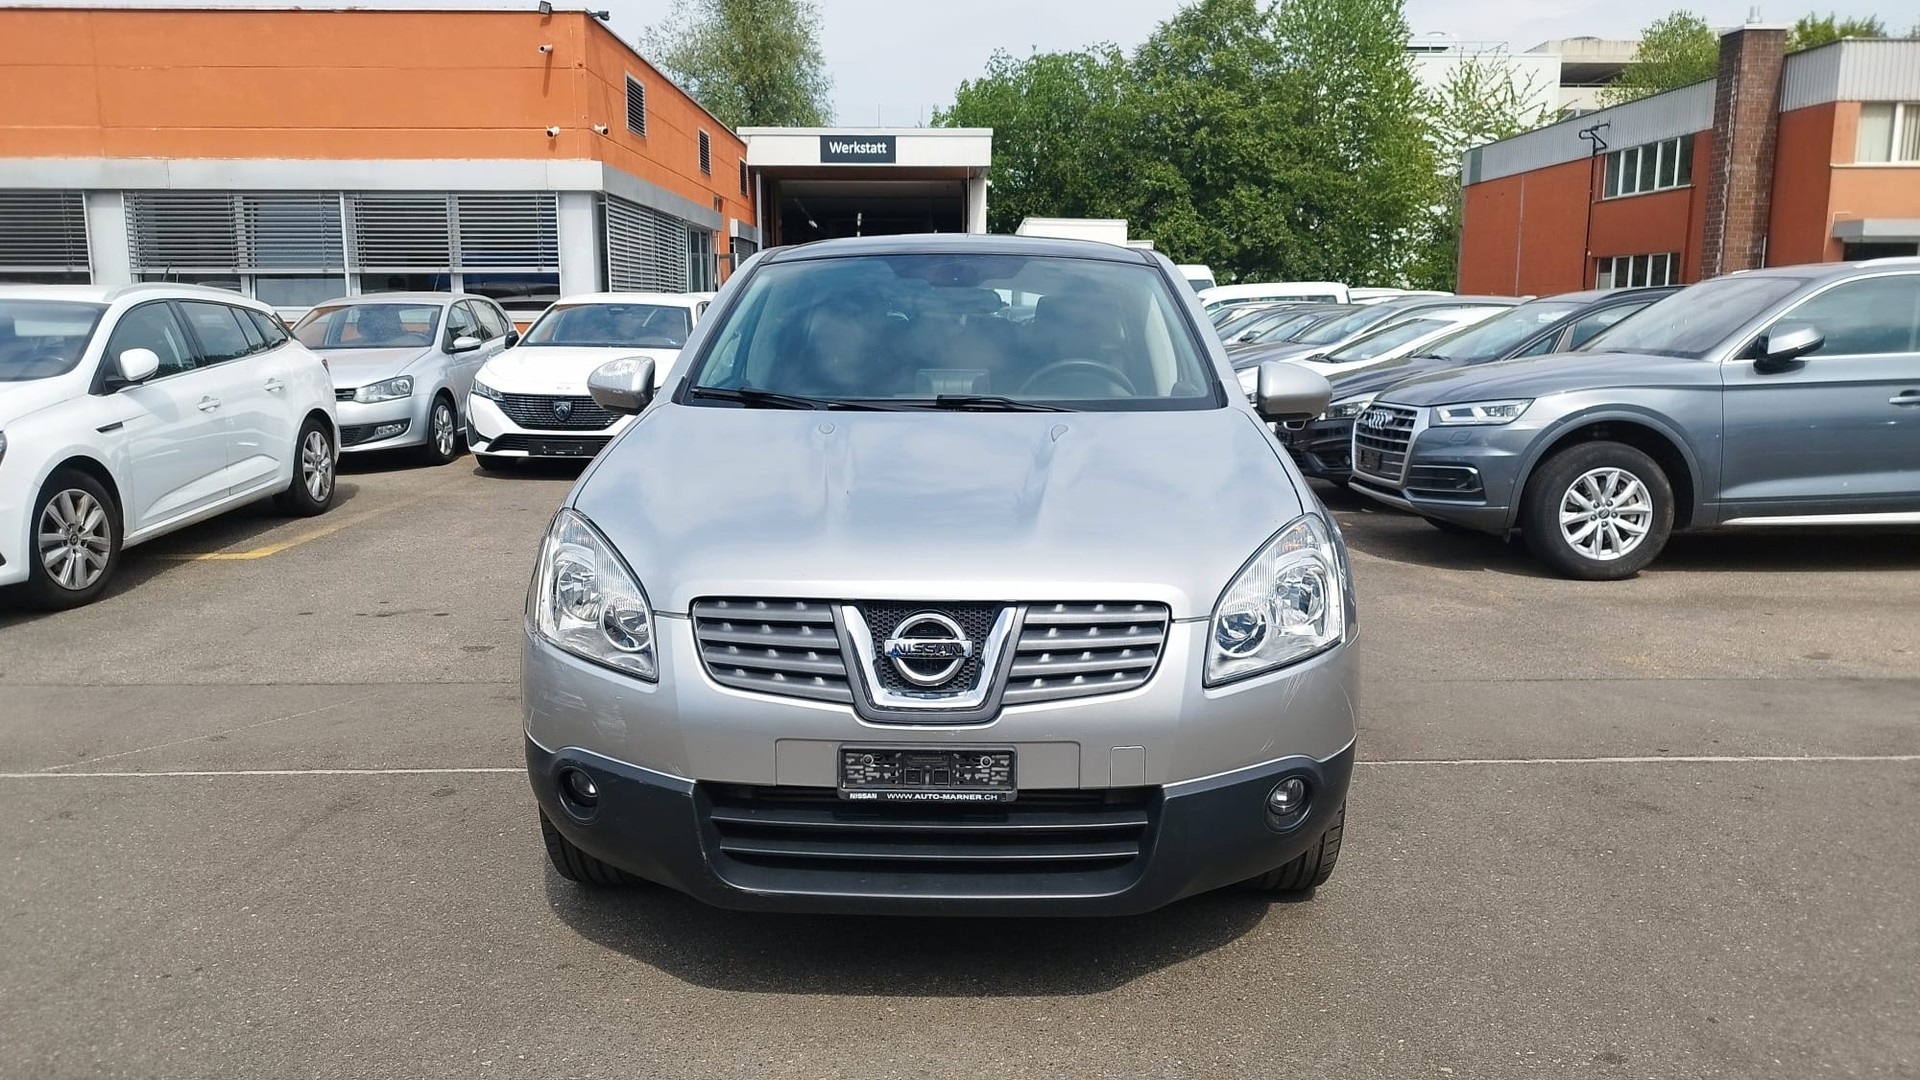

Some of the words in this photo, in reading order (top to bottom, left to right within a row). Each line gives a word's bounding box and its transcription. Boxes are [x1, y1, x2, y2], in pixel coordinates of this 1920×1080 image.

[829, 140, 887, 154] Werkstatt
[894, 642, 963, 655] NISSAN
[886, 793, 998, 801] WWW.AUTO-MARNER.CH
